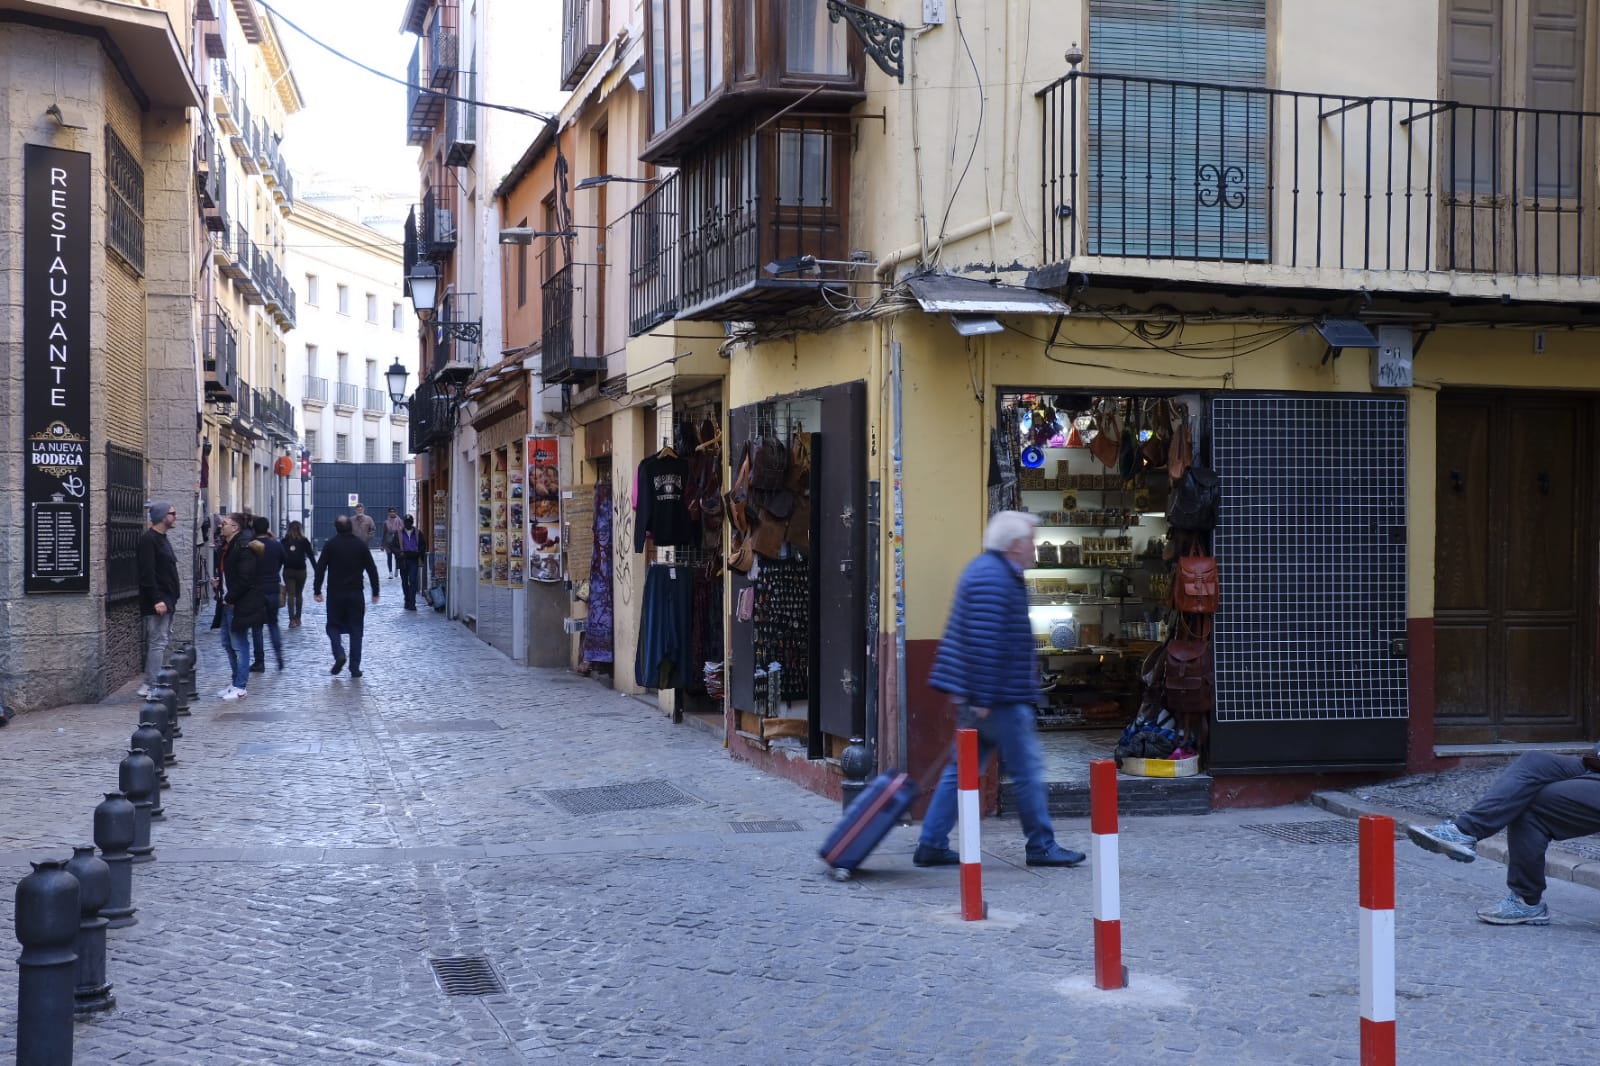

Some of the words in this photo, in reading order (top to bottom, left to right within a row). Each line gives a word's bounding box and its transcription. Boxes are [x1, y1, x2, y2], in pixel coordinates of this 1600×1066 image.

[49, 167, 67, 406] RESTAURANTE
[32, 442, 46, 451] LA
[48, 442, 83, 452] NUEVA
[32, 453, 83, 465] BODEGA
